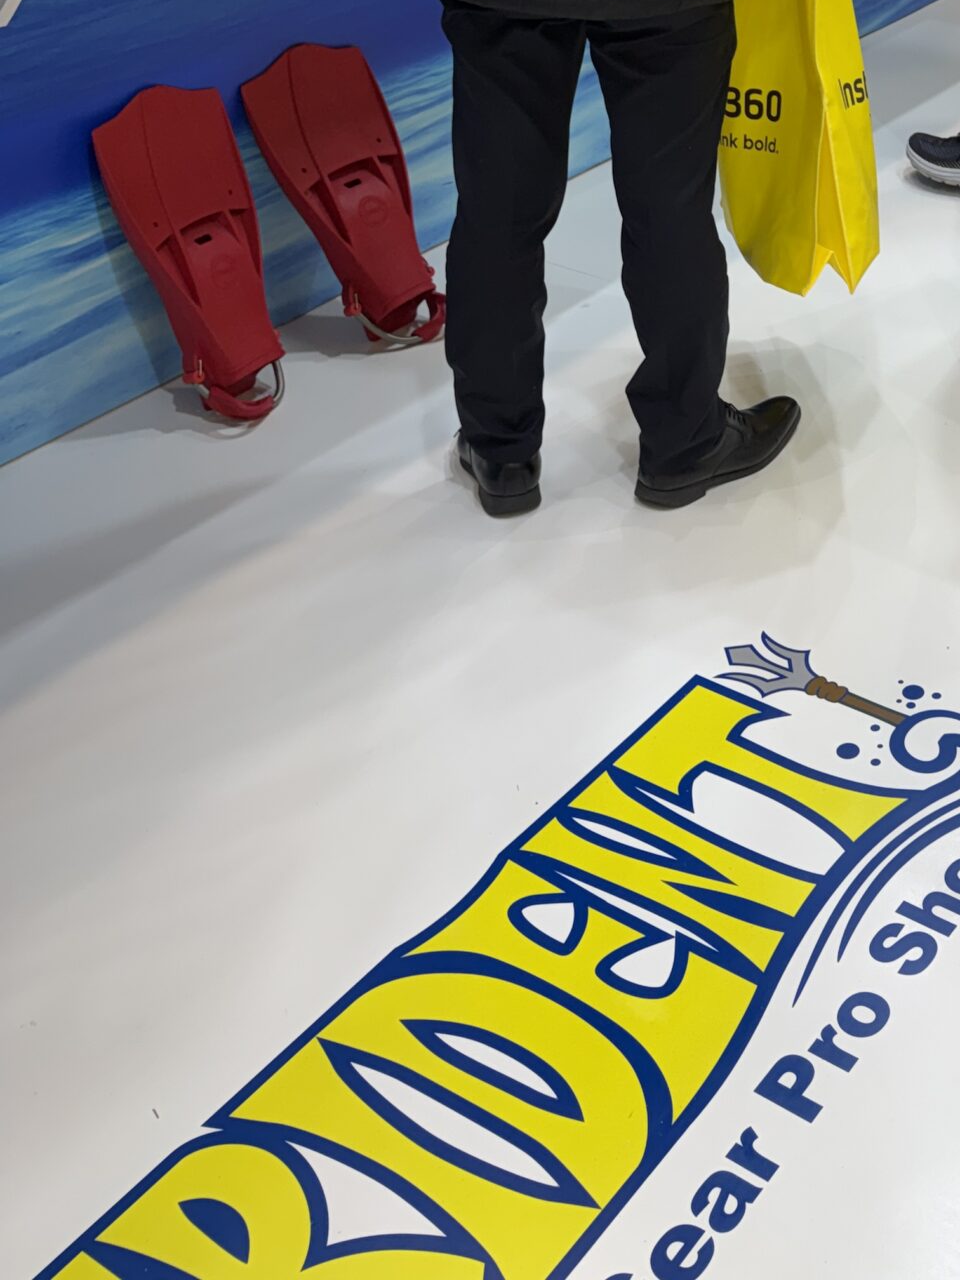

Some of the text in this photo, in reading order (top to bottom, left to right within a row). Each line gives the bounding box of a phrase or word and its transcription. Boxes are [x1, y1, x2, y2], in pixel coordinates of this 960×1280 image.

[724, 86, 782, 123] 360
[743, 134, 779, 154] bold.
[30, 673, 925, 1280] RIDENT
[603, 1125, 780, 1280] ear
[752, 990, 892, 1124] Pro
